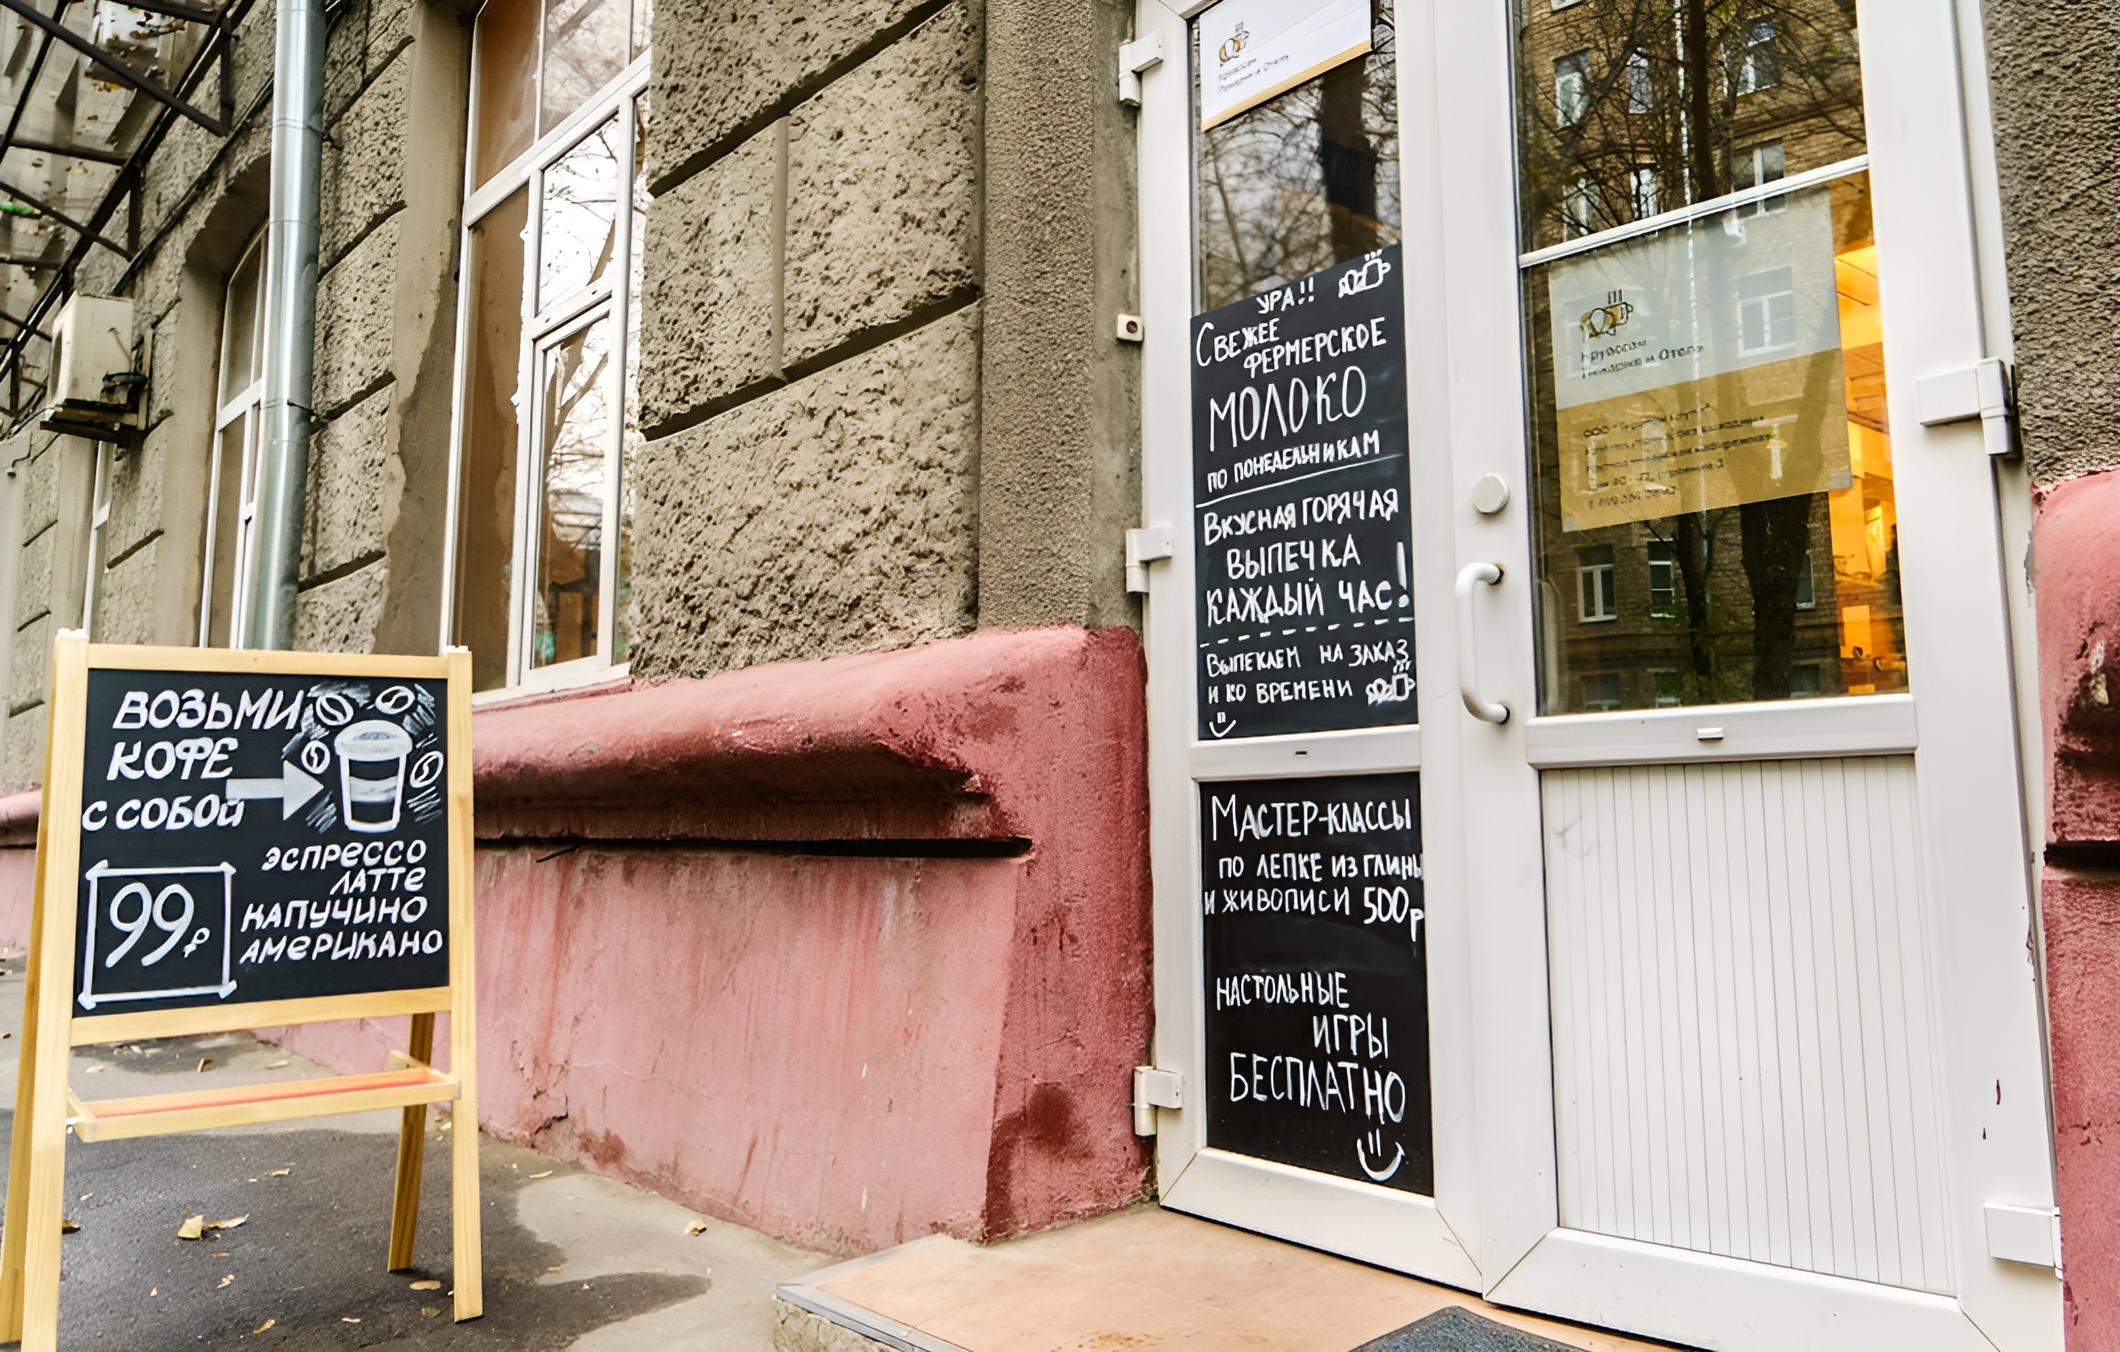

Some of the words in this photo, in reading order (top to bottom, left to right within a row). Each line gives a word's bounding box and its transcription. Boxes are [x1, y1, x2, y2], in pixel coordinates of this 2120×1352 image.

[1243, 316, 1387, 378] ФЕРМЕРСКОЕ
[1210, 366, 1366, 452] МОЛОКО
[1207, 469, 1227, 493] ПО
[1234, 430, 1380, 483] ПОНЕДЕЛЬНИКАМ
[1302, 488, 1399, 525] ГОРЯЧАЯ
[1226, 533, 1361, 579] ВЫПЕЧКА
[1206, 577, 1324, 628] КАЖДЫЙ
[1319, 644, 1344, 664] НА
[1348, 638, 1409, 667] ЗАКАЗ
[112, 688, 304, 730] ВОЗЬМИ
[1208, 686, 1219, 704] И
[1226, 683, 1246, 703] КО
[1256, 679, 1353, 704] ВРЕМЕНИ
[107, 736, 238, 780] КОФЕ
[1218, 856, 1244, 880] ПО
[1256, 852, 1323, 882] ЛЕПКЕ
[1332, 855, 1358, 877] ИЗ
[240, 896, 427, 933] КАПУЧИНО
[1221, 886, 1350, 916] ЖИВОПИСИ
[1216, 970, 1350, 1011] НАСТОЛЬНЫЕ
[1312, 1012, 1389, 1059] ИГРЫ
[1229, 1051, 1406, 1125] БЕСПЛАТНО
